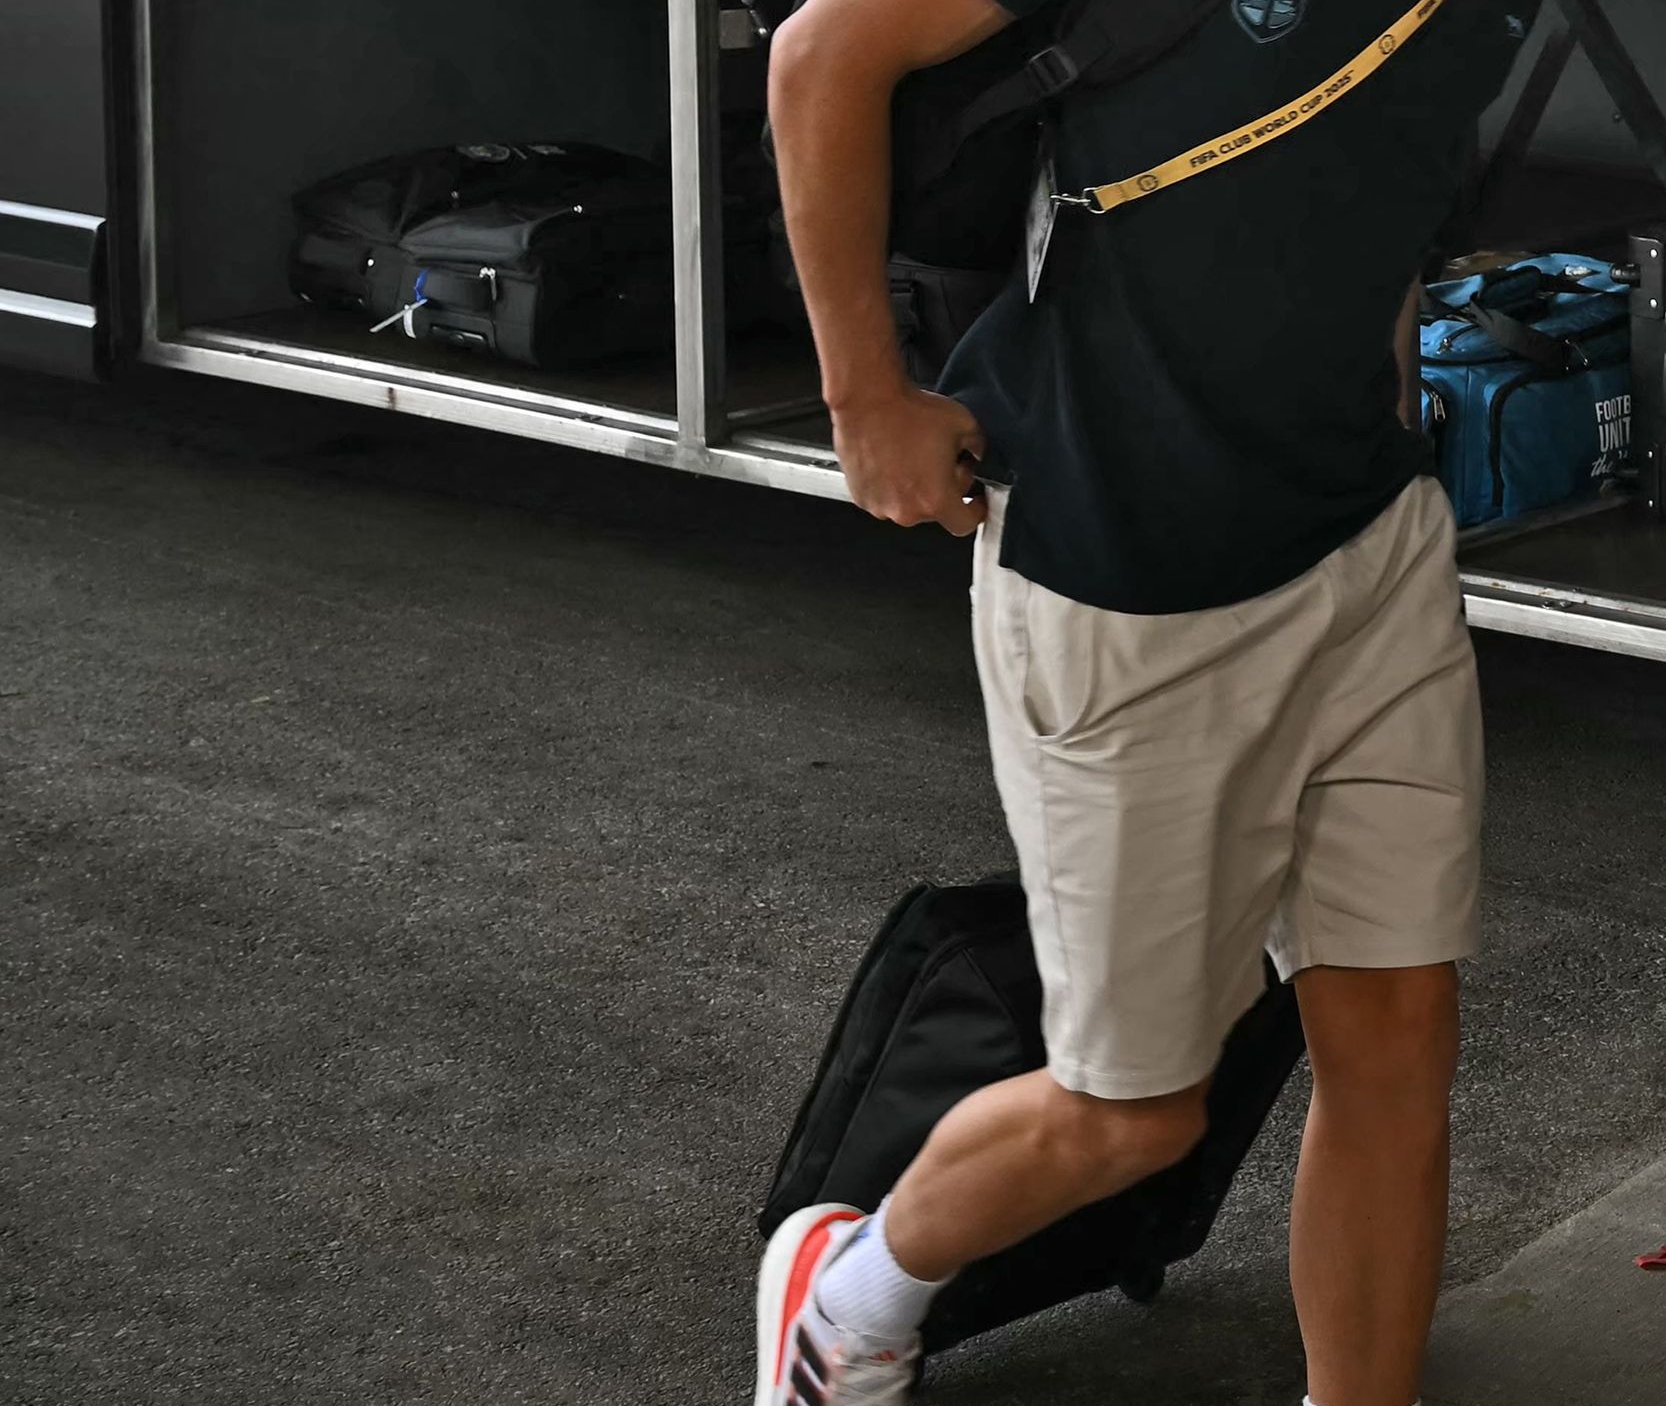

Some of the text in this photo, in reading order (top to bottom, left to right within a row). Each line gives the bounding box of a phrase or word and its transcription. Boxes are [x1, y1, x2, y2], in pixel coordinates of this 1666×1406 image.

[1189, 150, 1219, 168] FIFA
[1219, 134, 1252, 155] CLUB
[1252, 110, 1299, 139] WORLD
[1300, 94, 1323, 114] CUP
